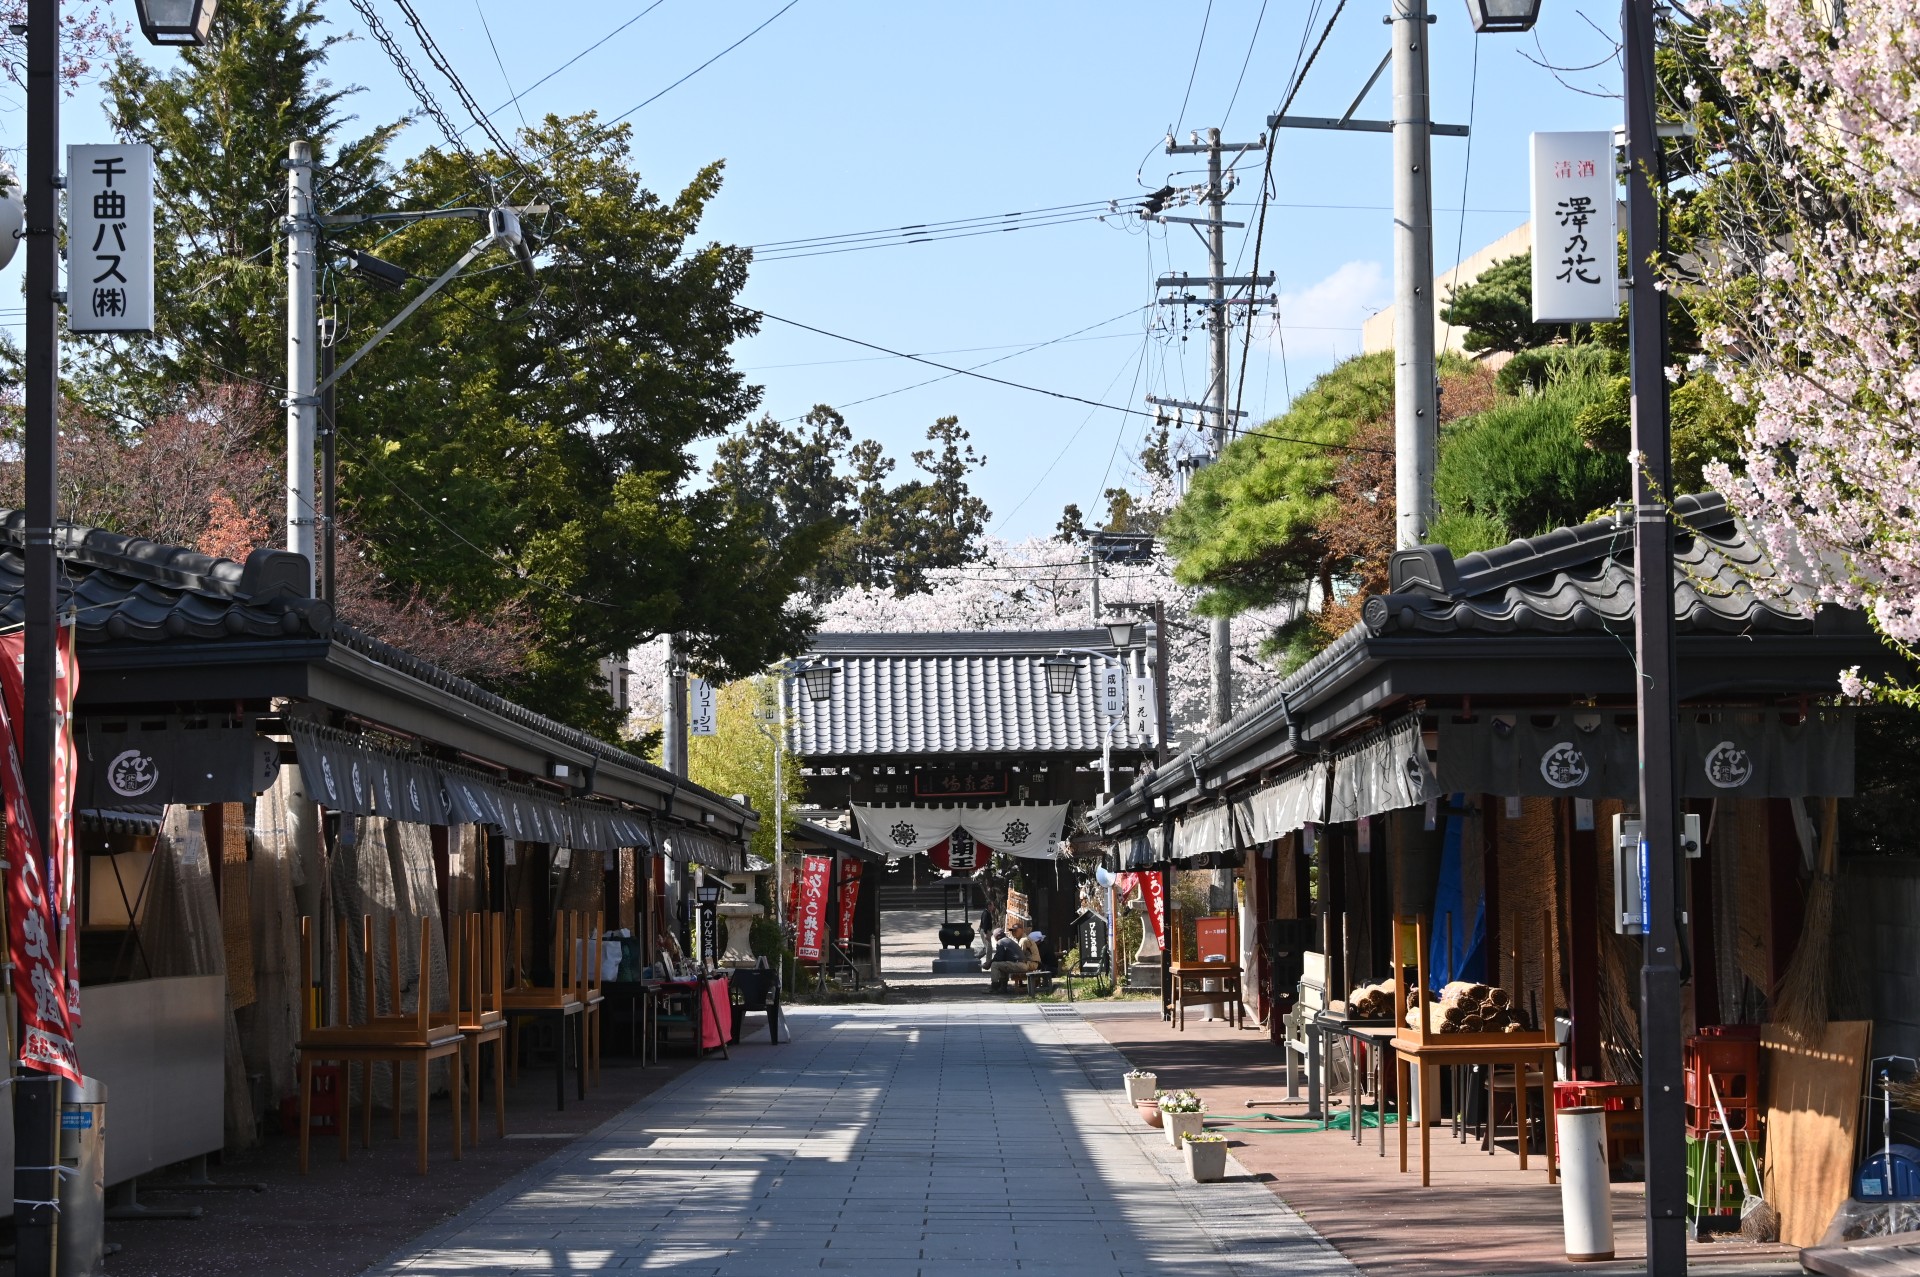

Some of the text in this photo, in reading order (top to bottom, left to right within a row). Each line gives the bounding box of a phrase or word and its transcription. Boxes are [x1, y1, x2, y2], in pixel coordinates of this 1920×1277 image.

[1554, 159, 1596, 179] 清酒
[1555, 196, 1601, 285] 澤乃花
[1107, 673, 1117, 711] 成田山
